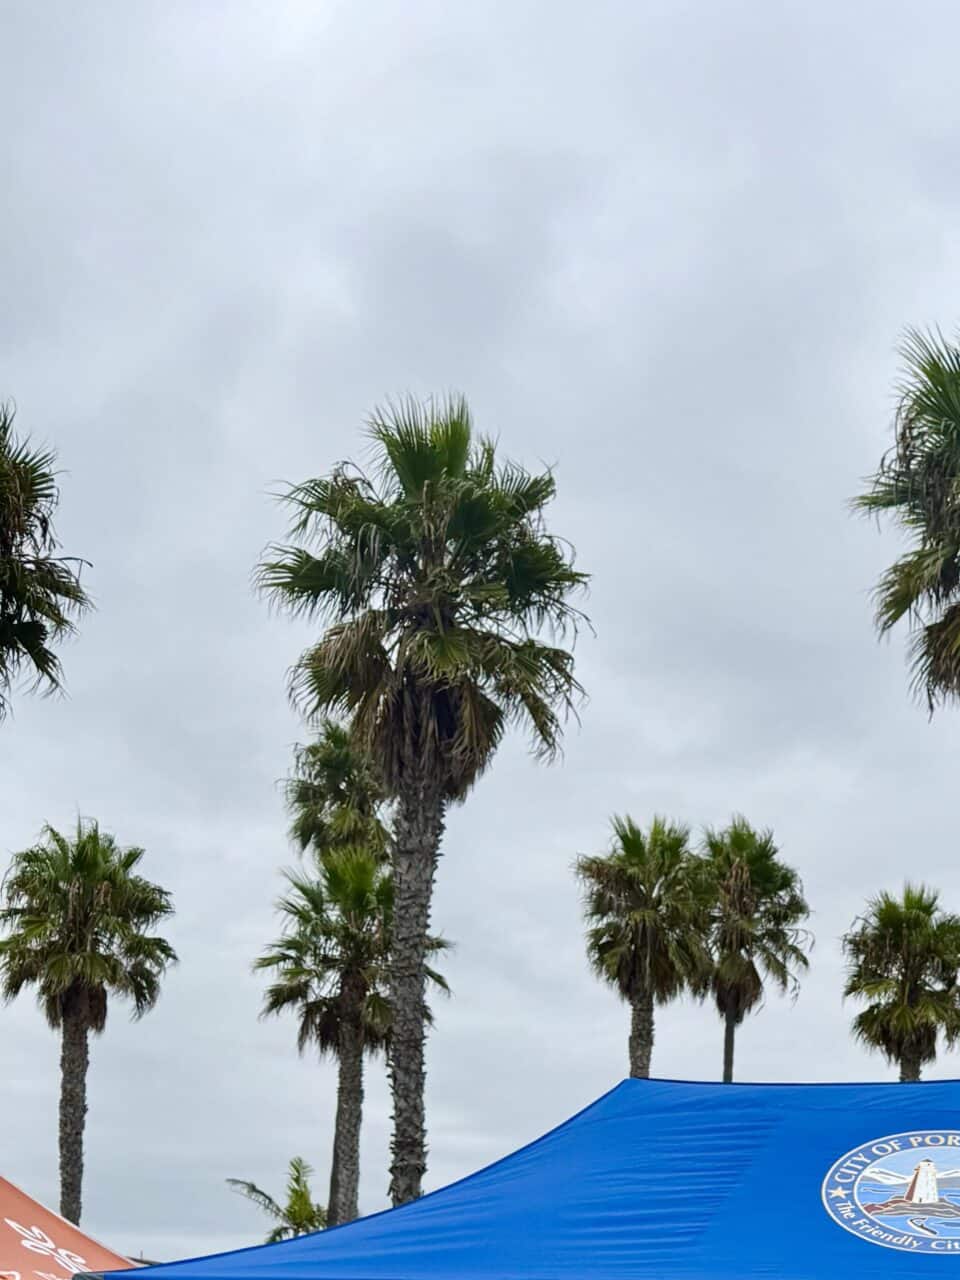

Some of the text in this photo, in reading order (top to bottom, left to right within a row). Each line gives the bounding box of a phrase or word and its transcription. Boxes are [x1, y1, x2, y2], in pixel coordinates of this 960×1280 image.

[833, 1151, 869, 1184] CITY
[871, 1138, 906, 1158] OF
[834, 1199, 855, 1221] The
[851, 1218, 923, 1250] Friendly
